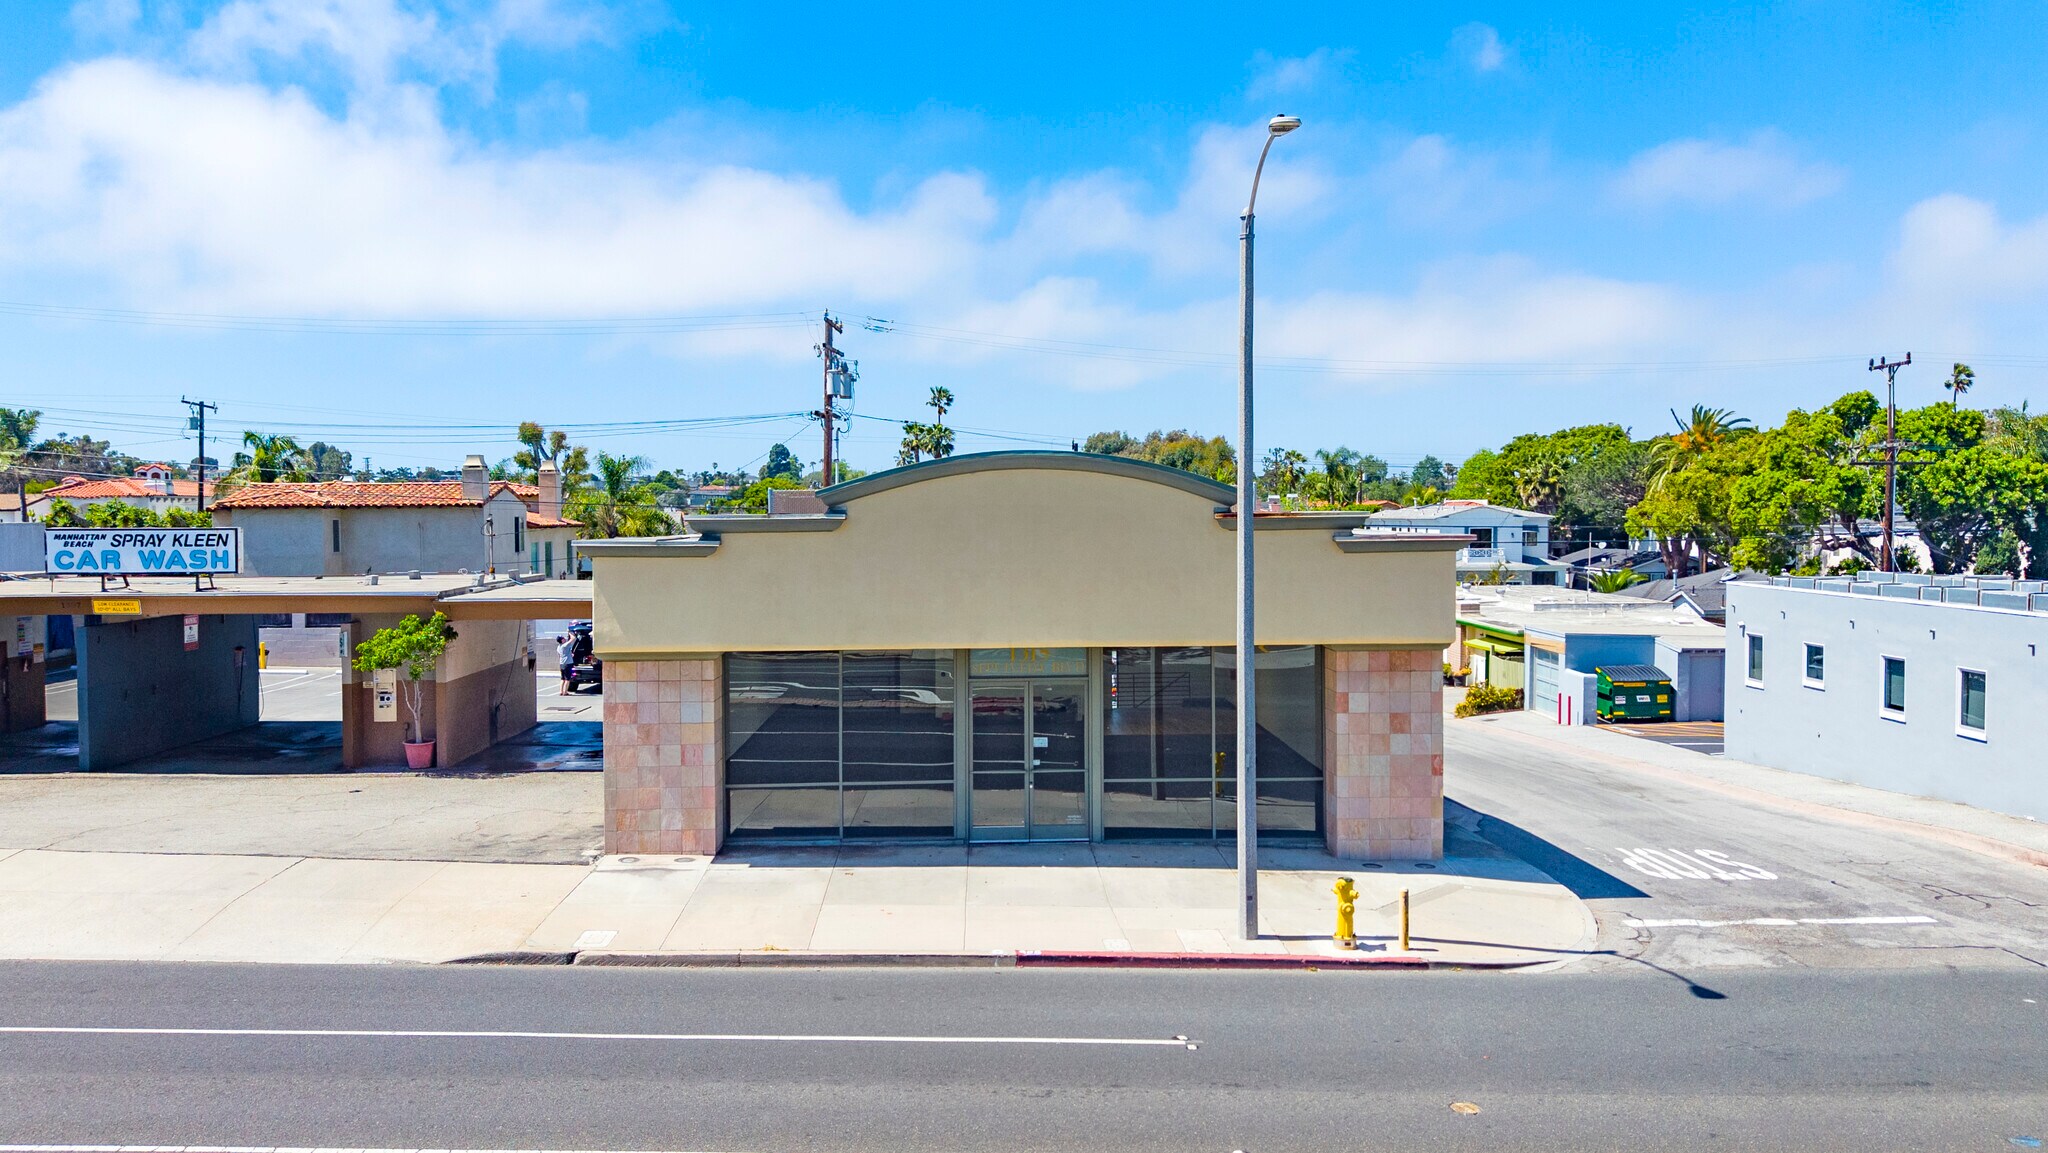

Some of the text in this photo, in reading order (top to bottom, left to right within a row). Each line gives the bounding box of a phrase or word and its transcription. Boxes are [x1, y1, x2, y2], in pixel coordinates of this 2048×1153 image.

[53, 533, 107, 541] MANHATTAN
[63, 540, 94, 548] BEACH
[110, 533, 229, 548] SPRAY KLEEN
[54, 549, 229, 570] CAR WASH
[1614, 848, 1778, 880] STOP
